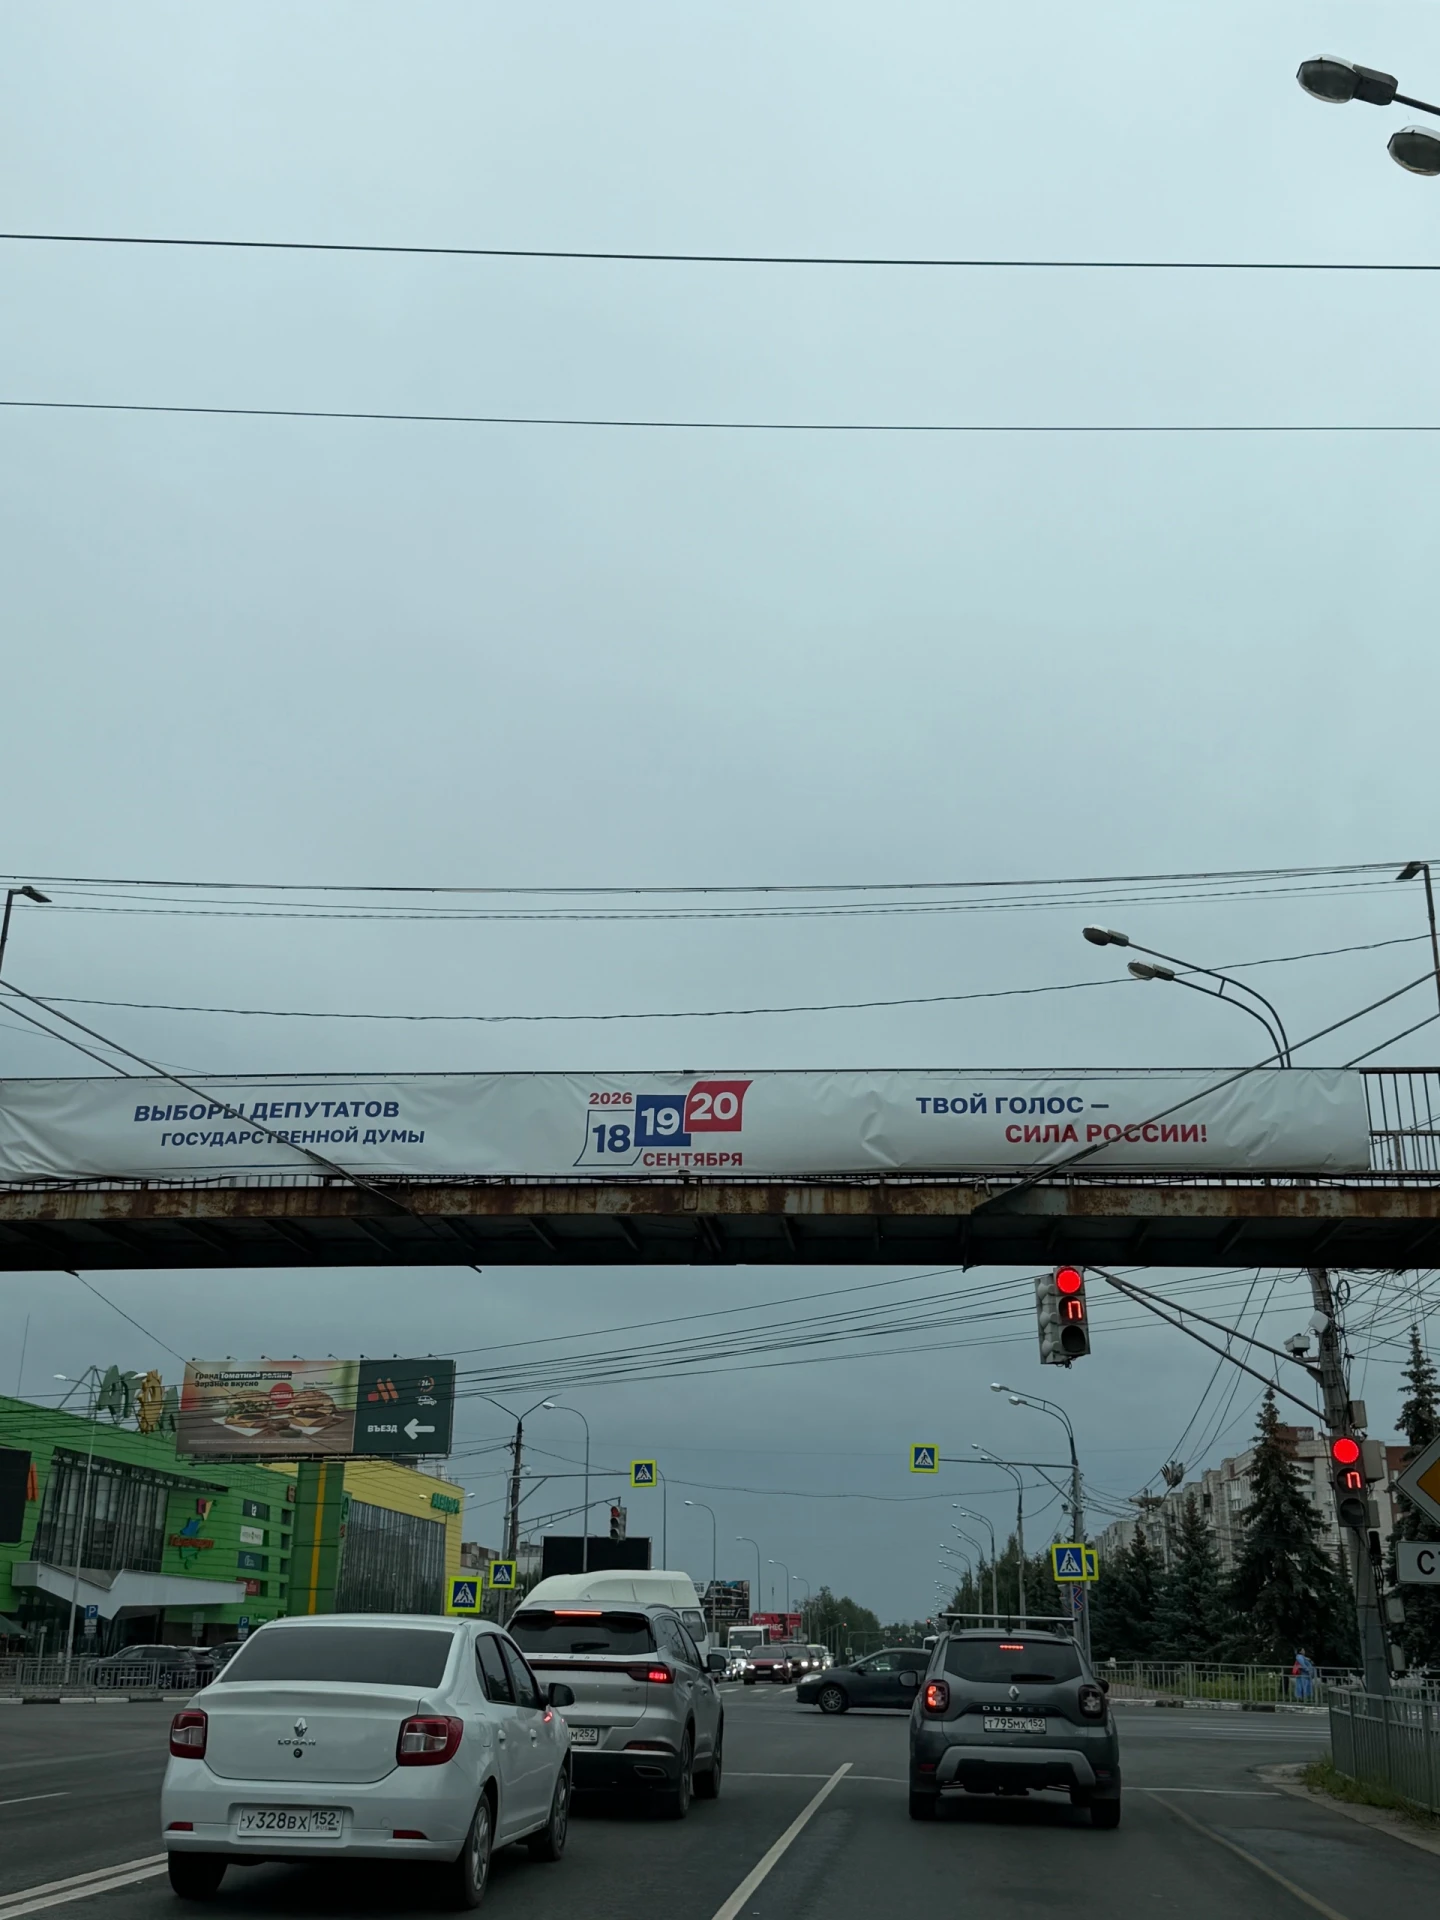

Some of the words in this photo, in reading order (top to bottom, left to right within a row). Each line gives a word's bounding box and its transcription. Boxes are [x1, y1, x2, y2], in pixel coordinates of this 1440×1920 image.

[589, 1092, 633, 1105] 2026
[689, 1091, 739, 1120] 20
[915, 1093, 988, 1115] ТВОЙ
[995, 1096, 1084, 1115] ГОЛОС
[133, 1103, 245, 1122] ВЫБОРЫ
[250, 1101, 400, 1122] ДЕПУТАТОВ
[641, 1107, 681, 1136] 19
[161, 1127, 359, 1147] ГОСУДАРСТВЕННОЙ
[362, 1130, 425, 1147] ДУМЫ
[592, 1124, 631, 1153] 18
[1005, 1123, 1079, 1143] СИЛА
[1086, 1123, 1208, 1143] РОССИИ!
[642, 1152, 743, 1167] СЕНТЯБРЯ
[194, 1372, 219, 1381] Гранд
[220, 1371, 260, 1379] Томатный
[230, 1380, 259, 1388] вкусно
[367, 1424, 398, 1434] ВЪЕЗД
[1417, 1550, 1440, 1575] С
[982, 1705, 1046, 1714] DUSTER
[987, 1717, 1026, 1729] Т795МХ
[1028, 1718, 1044, 1727] 152
[579, 1728, 596, 1738] 252
[277, 1738, 317, 1747] LOGAN
[246, 1811, 308, 1831] У328ВХ
[311, 1811, 336, 1826] 152
